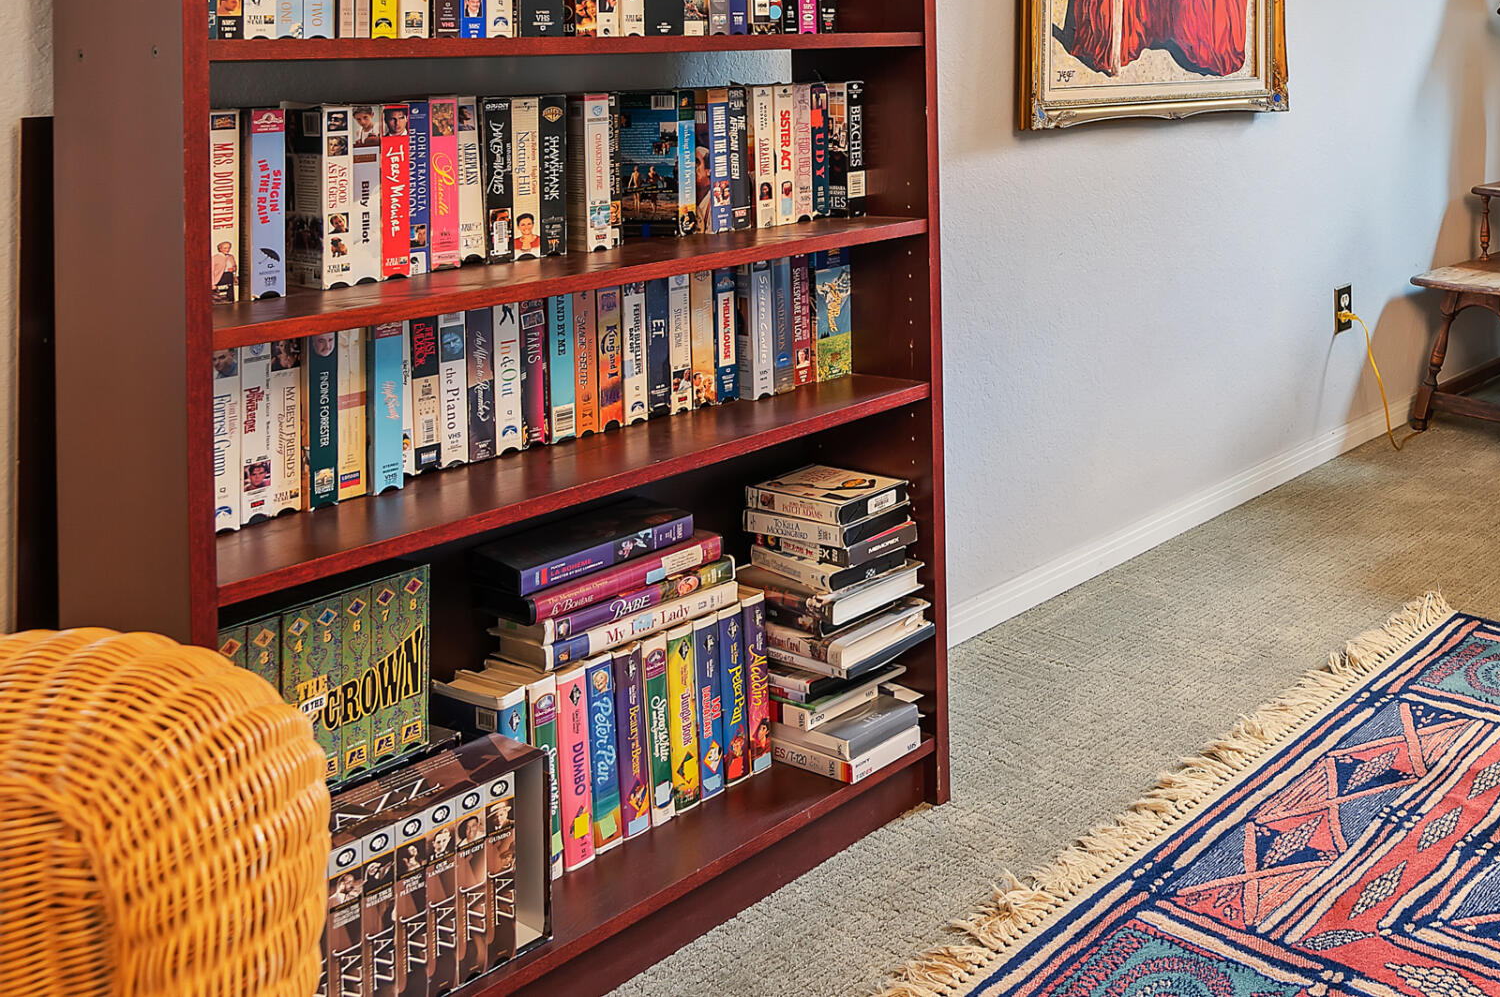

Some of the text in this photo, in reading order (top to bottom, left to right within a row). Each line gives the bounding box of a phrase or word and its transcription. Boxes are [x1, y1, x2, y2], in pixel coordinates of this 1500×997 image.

[281, 1, 292, 25] ONE
[312, 1, 322, 27] TWO
[713, 105, 727, 178] INHERIT THE WIND
[729, 116, 740, 180] AFRICAN QUEEN
[737, 115, 745, 130] THE
[780, 109, 791, 172] SISTER ACT
[850, 105, 862, 167] BEACHES
[213, 142, 234, 230] MRS. DOUBTFIRE
[257, 159, 271, 225] IN THE RAIN
[269, 169, 282, 215] SINGIN'
[416, 132, 426, 212] JOHN TRAVOLTA
[464, 143, 479, 185] SLEEPLESS
[516, 131, 530, 196] Notting Hill
[549, 135, 560, 201] SHAWSHANK
[360, 181, 370, 244] Billy Elliot
[651, 319, 665, 339] E.T.
[758, 275, 769, 364] Sixteen Candles
[792, 267, 803, 343] SHAKESPEARE IN LOVE
[527, 332, 540, 364] PARIS
[601, 325, 618, 379] King and I
[632, 303, 642, 375] FERRIS BUELLER'S
[723, 331, 731, 360] LOUISE
[319, 371, 329, 448] FINDING FORRESTER
[446, 367, 460, 430] the Piano
[286, 386, 296, 478] MY BEST FRIEND'S
[766, 525, 809, 540] MOCKINGBIRD
[773, 518, 783, 528] TO
[783, 520, 794, 529] KILL
[868, 536, 900, 554] MEMOREX
[323, 630, 332, 643] 5
[353, 620, 361, 631] 6
[382, 609, 390, 622] 7
[610, 595, 650, 621] BABE
[260, 651, 270, 664] 3
[294, 640, 303, 652] 4
[747, 644, 767, 707] Aladdin
[296, 674, 328, 701] THE
[323, 624, 424, 731] CROWN
[728, 665, 744, 726] Peter Pan
[651, 695, 671, 763] Snow White
[679, 693, 693, 747] Jungle Book
[701, 686, 713, 739] DALMATIANS
[711, 696, 721, 721] 101
[573, 742, 586, 797] DUMBO
[593, 696, 616, 786] Peter Pan
[628, 705, 641, 776] Beauty Beast
[488, 831, 512, 844] GUMBO
[429, 894, 457, 957] JAZZ
[459, 882, 486, 941] JAZZ
[487, 866, 515, 926] JAZZ
[366, 926, 395, 991] JAZZ
[401, 908, 428, 974] JAZZ
